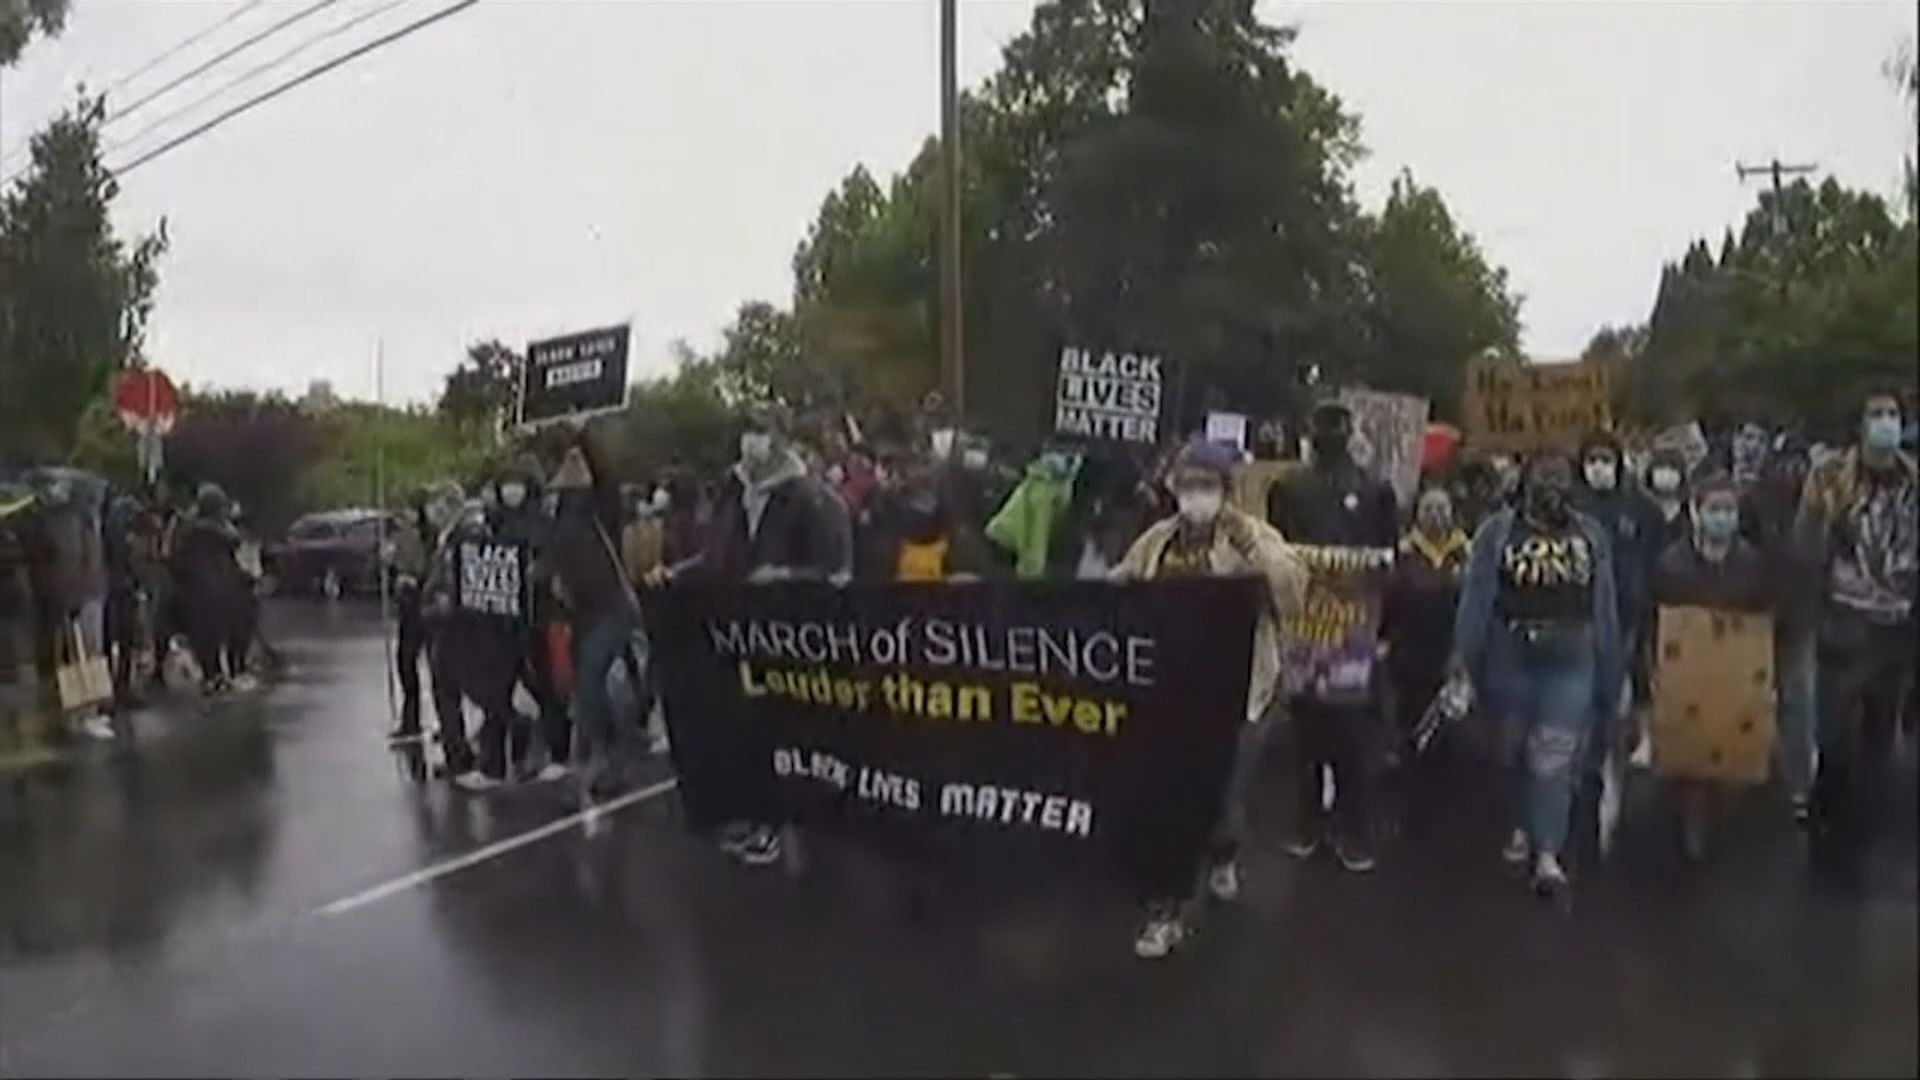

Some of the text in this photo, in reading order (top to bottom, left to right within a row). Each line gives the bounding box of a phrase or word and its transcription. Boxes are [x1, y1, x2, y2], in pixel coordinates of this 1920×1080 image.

[1061, 347, 1162, 380] BLACK
[1062, 378, 1155, 411] LIVES
[1055, 409, 1158, 444] MATTER
[709, 616, 1155, 686] MARCH of SILENCE
[738, 659, 1128, 736] Louder than Ever
[773, 748, 1093, 838] BLACK LIVES MATTER
